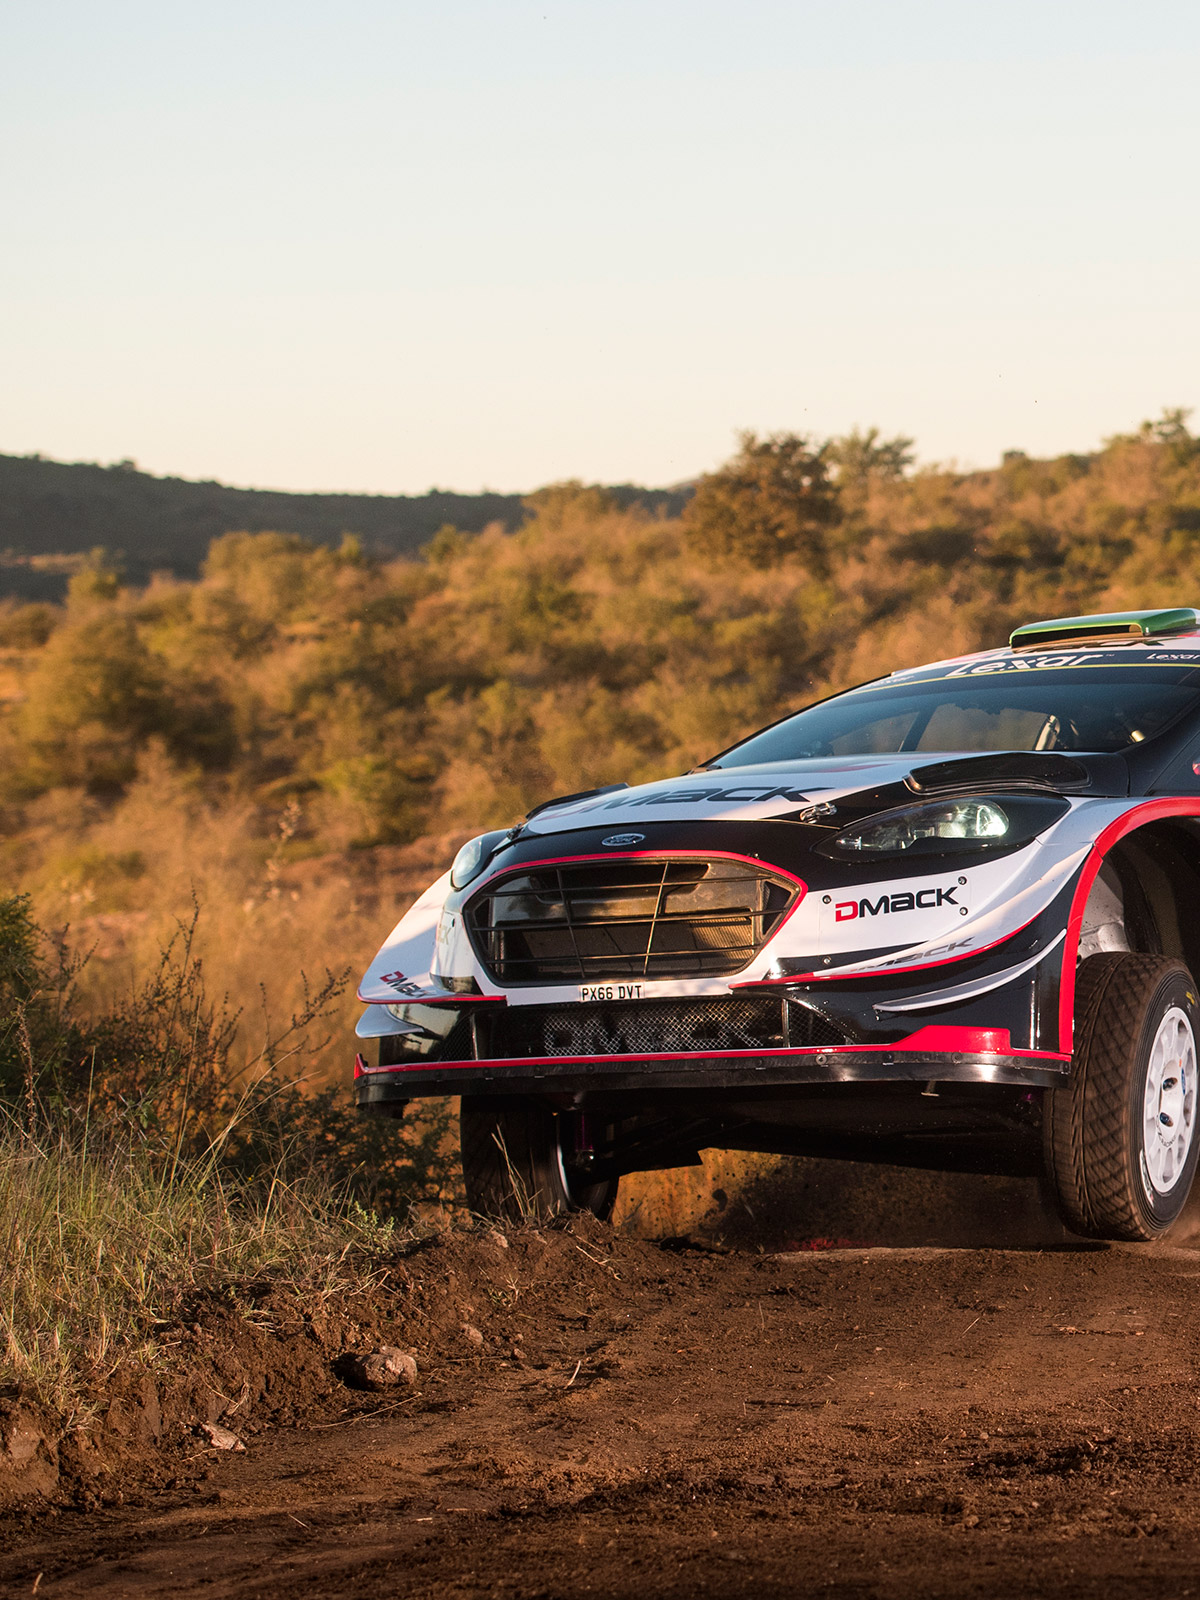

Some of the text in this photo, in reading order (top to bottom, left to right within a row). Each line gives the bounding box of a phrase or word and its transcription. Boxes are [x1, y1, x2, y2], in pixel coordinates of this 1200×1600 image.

[944, 652, 1104, 678] Lexar
[582, 985, 642, 1001] PX66 DVT
